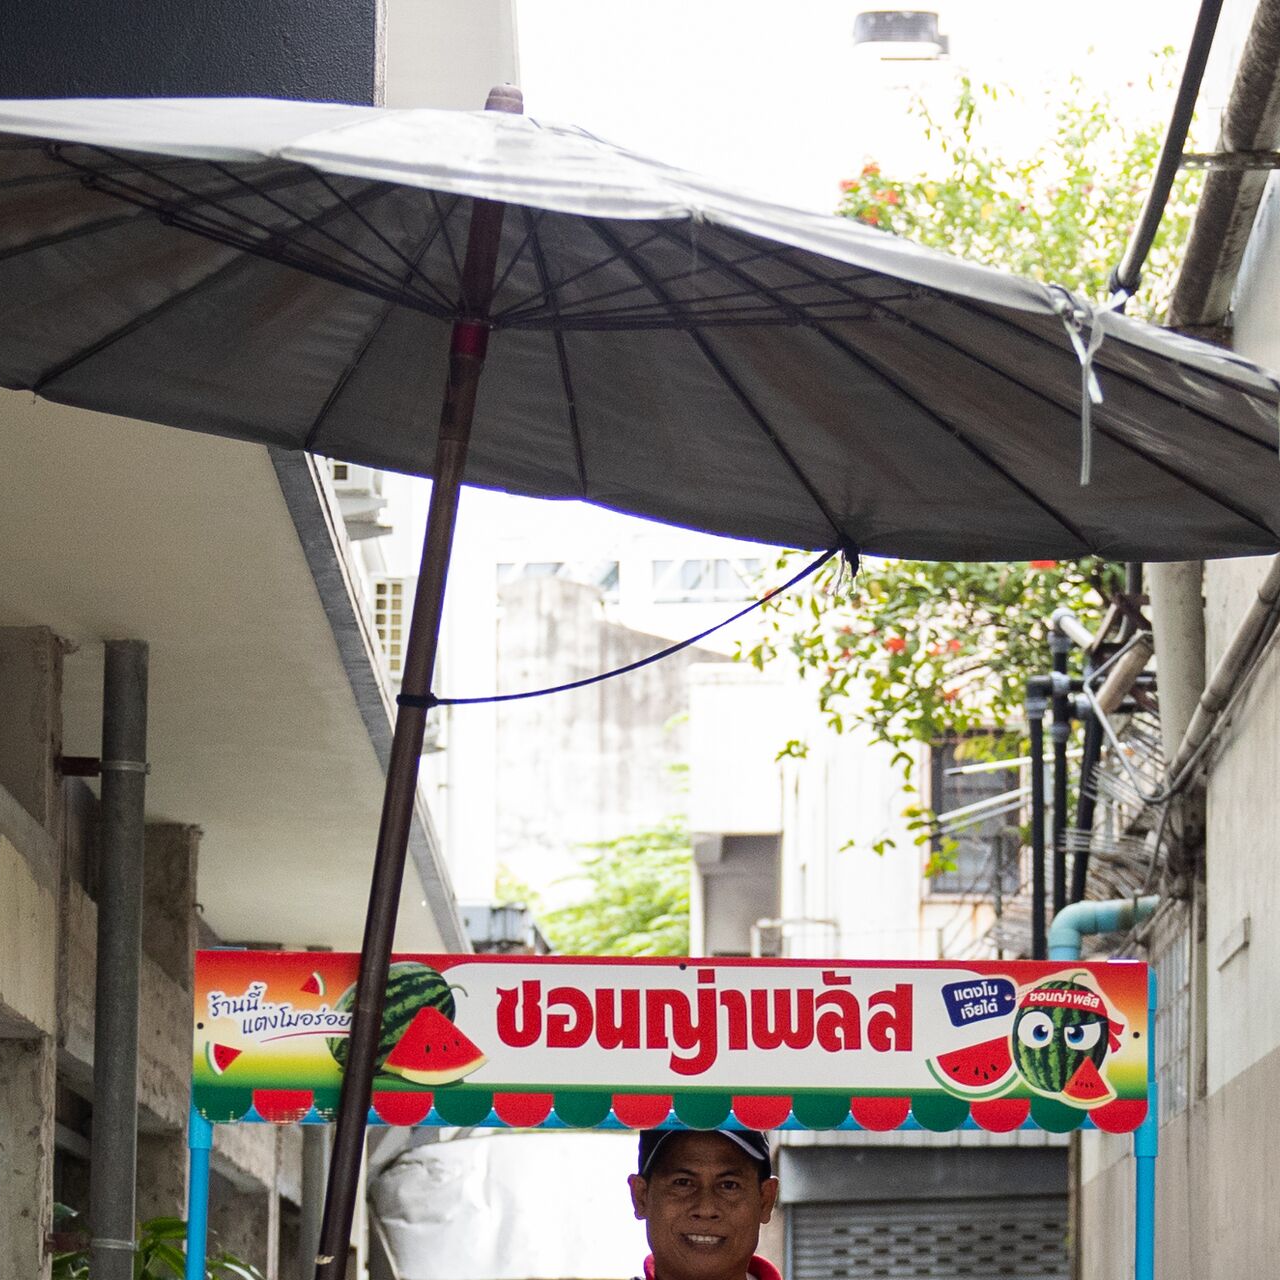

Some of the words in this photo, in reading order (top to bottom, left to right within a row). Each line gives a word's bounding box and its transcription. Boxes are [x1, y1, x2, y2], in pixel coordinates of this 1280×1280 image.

[496, 969, 913, 1076] ซอนญ่าพลัส
[953, 981, 999, 1001] แตงโม
